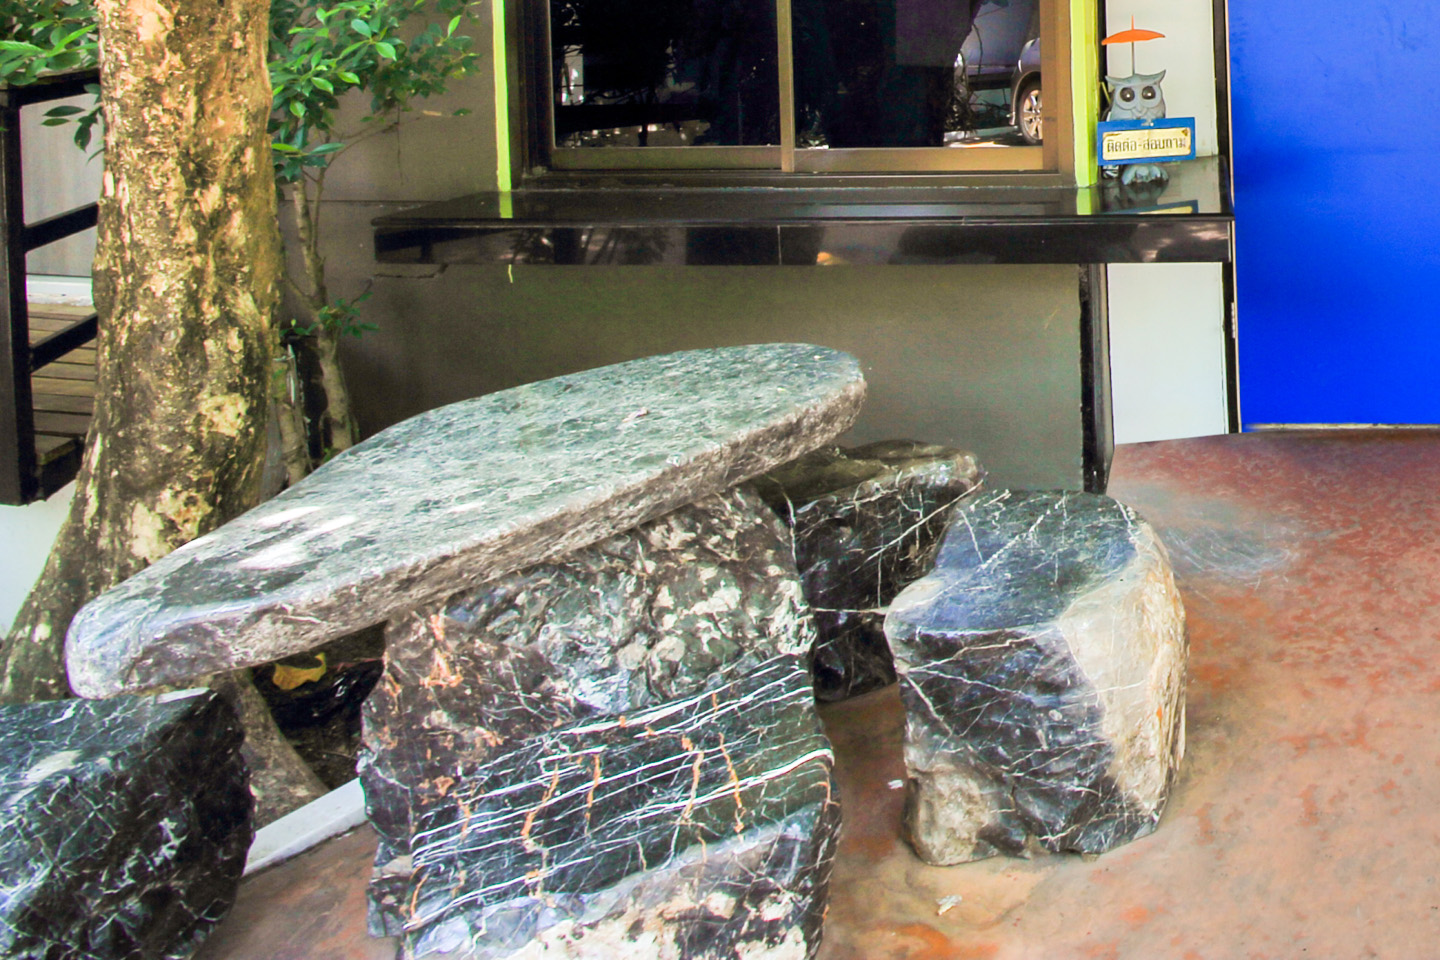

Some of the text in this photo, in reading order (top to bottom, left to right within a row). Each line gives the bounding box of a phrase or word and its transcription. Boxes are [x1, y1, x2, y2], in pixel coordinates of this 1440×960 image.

[1106, 136, 1187, 154] ติดต่อ-สอบถาม
